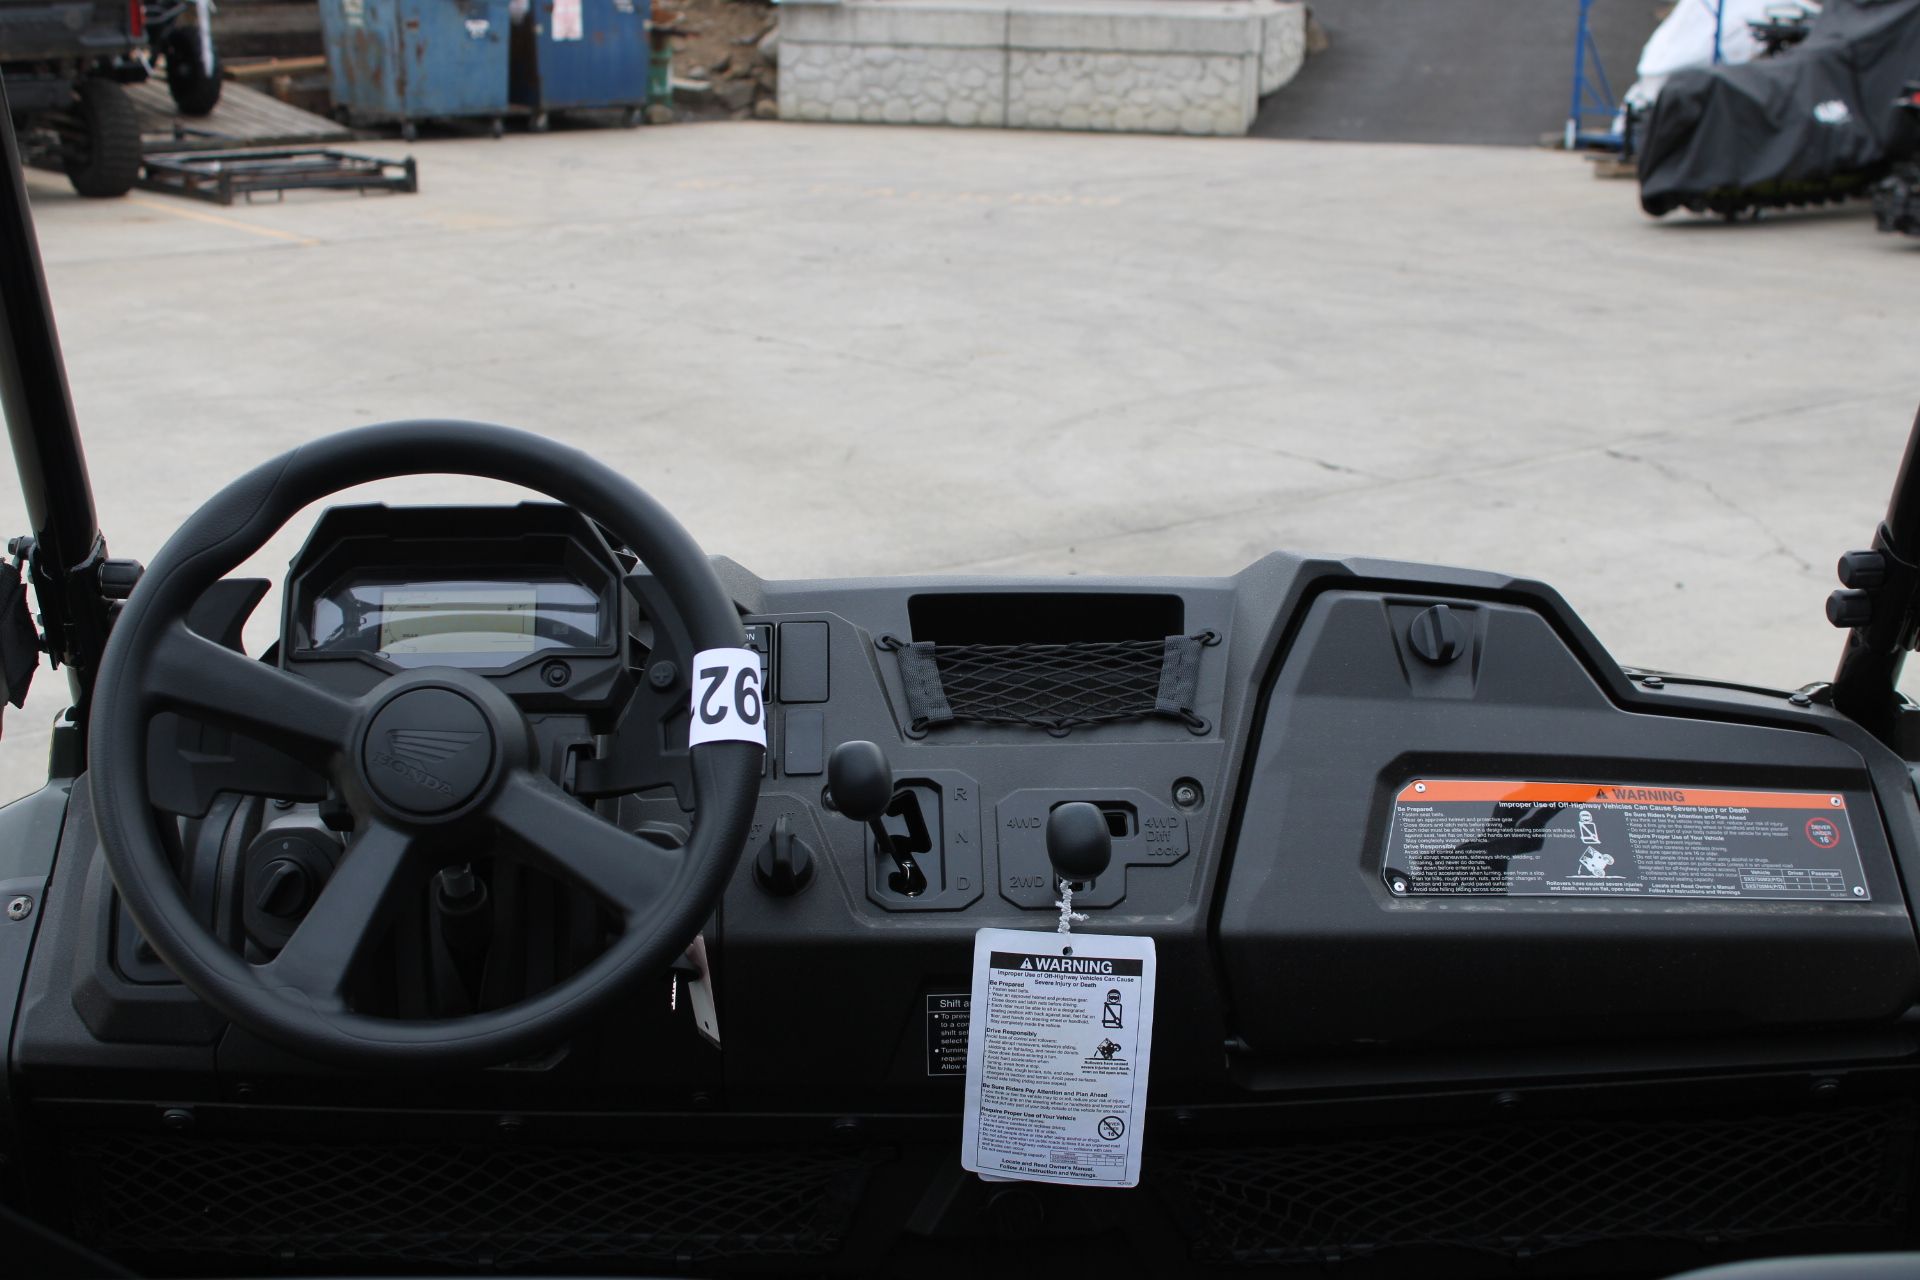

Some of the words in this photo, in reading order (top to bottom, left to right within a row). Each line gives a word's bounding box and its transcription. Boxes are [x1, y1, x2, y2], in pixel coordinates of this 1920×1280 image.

[373, 752, 460, 798] HONDA
[954, 788, 967, 800] R
[1612, 788, 1684, 802] WARNING
[1006, 818, 1042, 828] 4WD
[1145, 817, 1178, 828] 4WD
[956, 832, 968, 843] N
[1146, 831, 1170, 842] Diff
[957, 877, 970, 890] D
[1010, 876, 1044, 888] 2WD
[1035, 957, 1113, 974] WARNING
[940, 1000, 960, 1008] Shift
[1002, 1029, 1038, 1038] Responsibly
[982, 1107, 1003, 1115] Require
